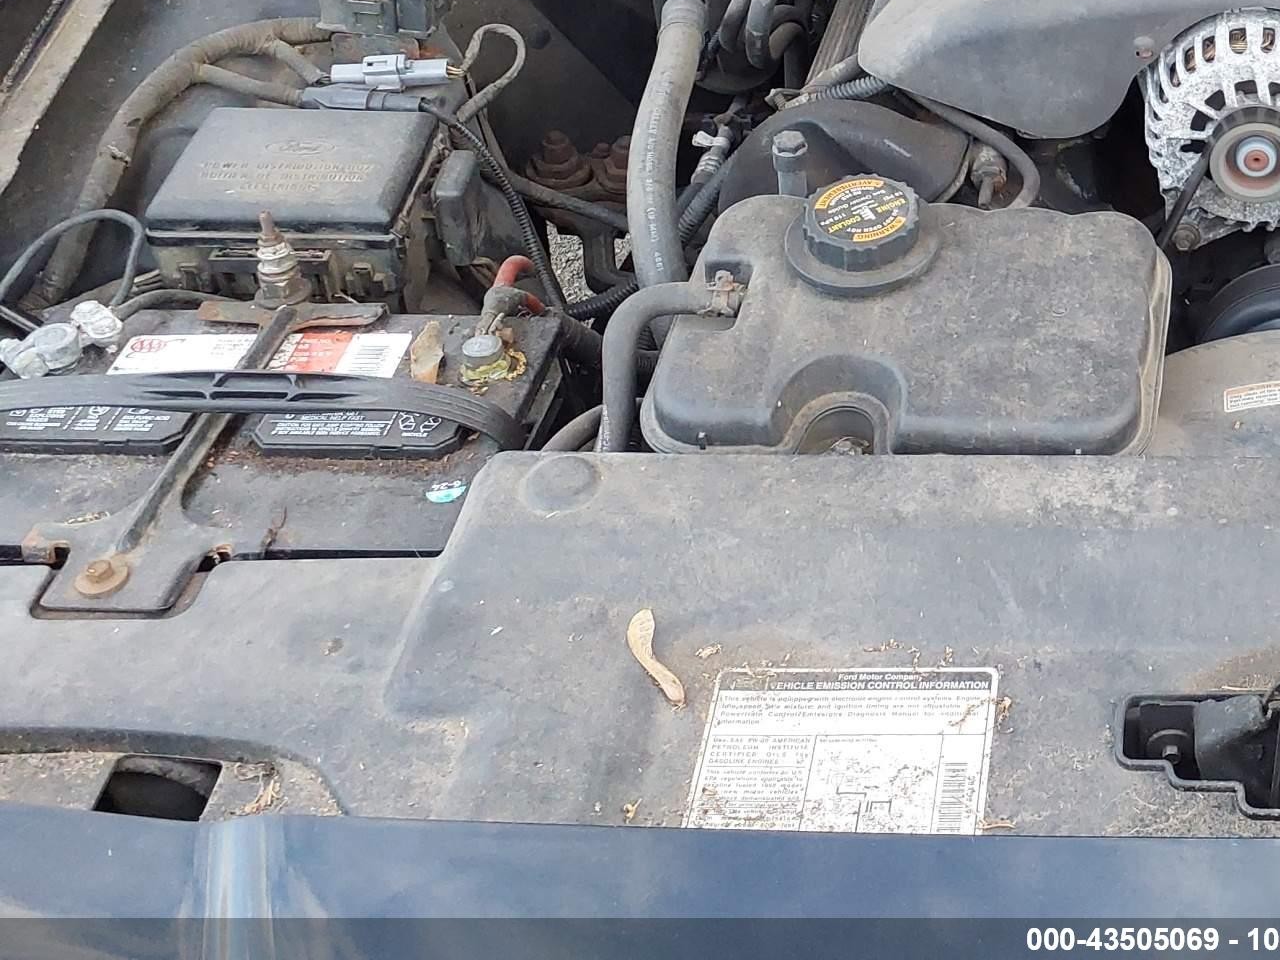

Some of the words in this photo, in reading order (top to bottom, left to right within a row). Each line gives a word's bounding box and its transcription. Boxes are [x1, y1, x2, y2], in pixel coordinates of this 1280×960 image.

[827, 215, 861, 234] COOLANT
[816, 681, 865, 690] EMISSION
[867, 681, 918, 690] CONTROL
[918, 680, 990, 690] INFORMATION
